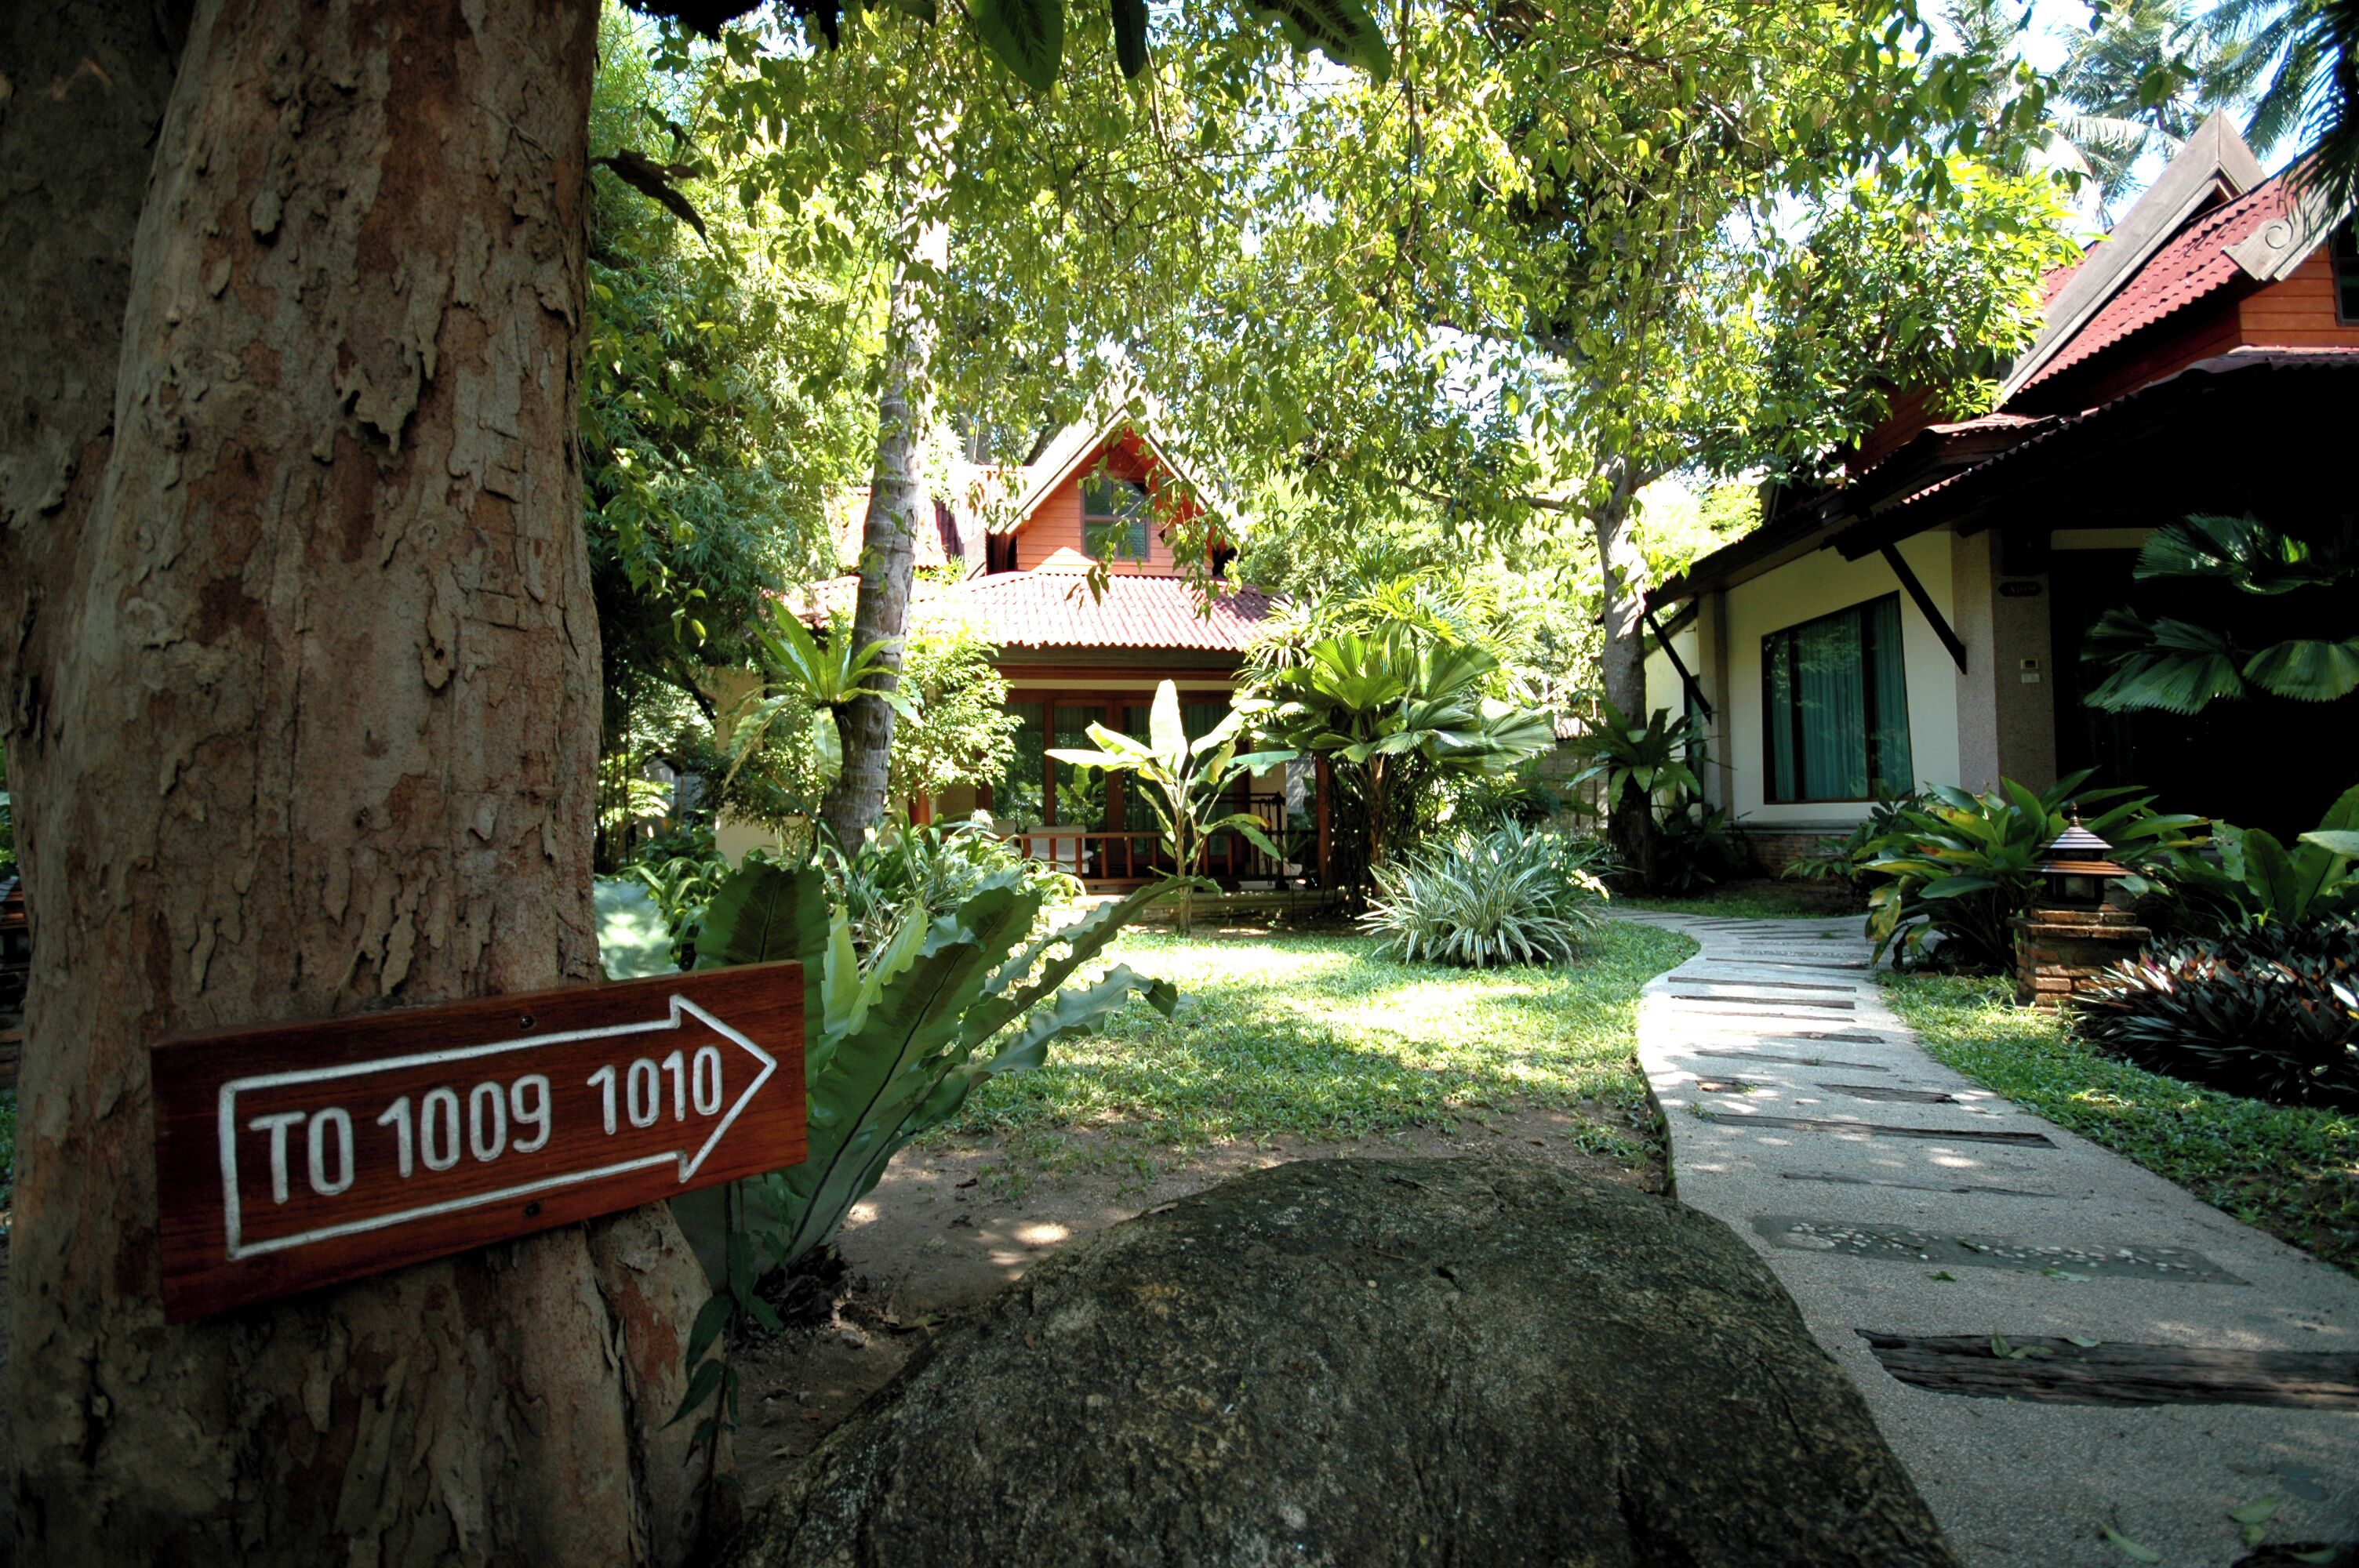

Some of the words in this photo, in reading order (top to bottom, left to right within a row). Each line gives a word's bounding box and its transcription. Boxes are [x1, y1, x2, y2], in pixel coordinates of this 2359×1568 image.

[249, 1107, 355, 1205] TO
[376, 1073, 552, 1178] 1009
[586, 1045, 723, 1136] 1010
